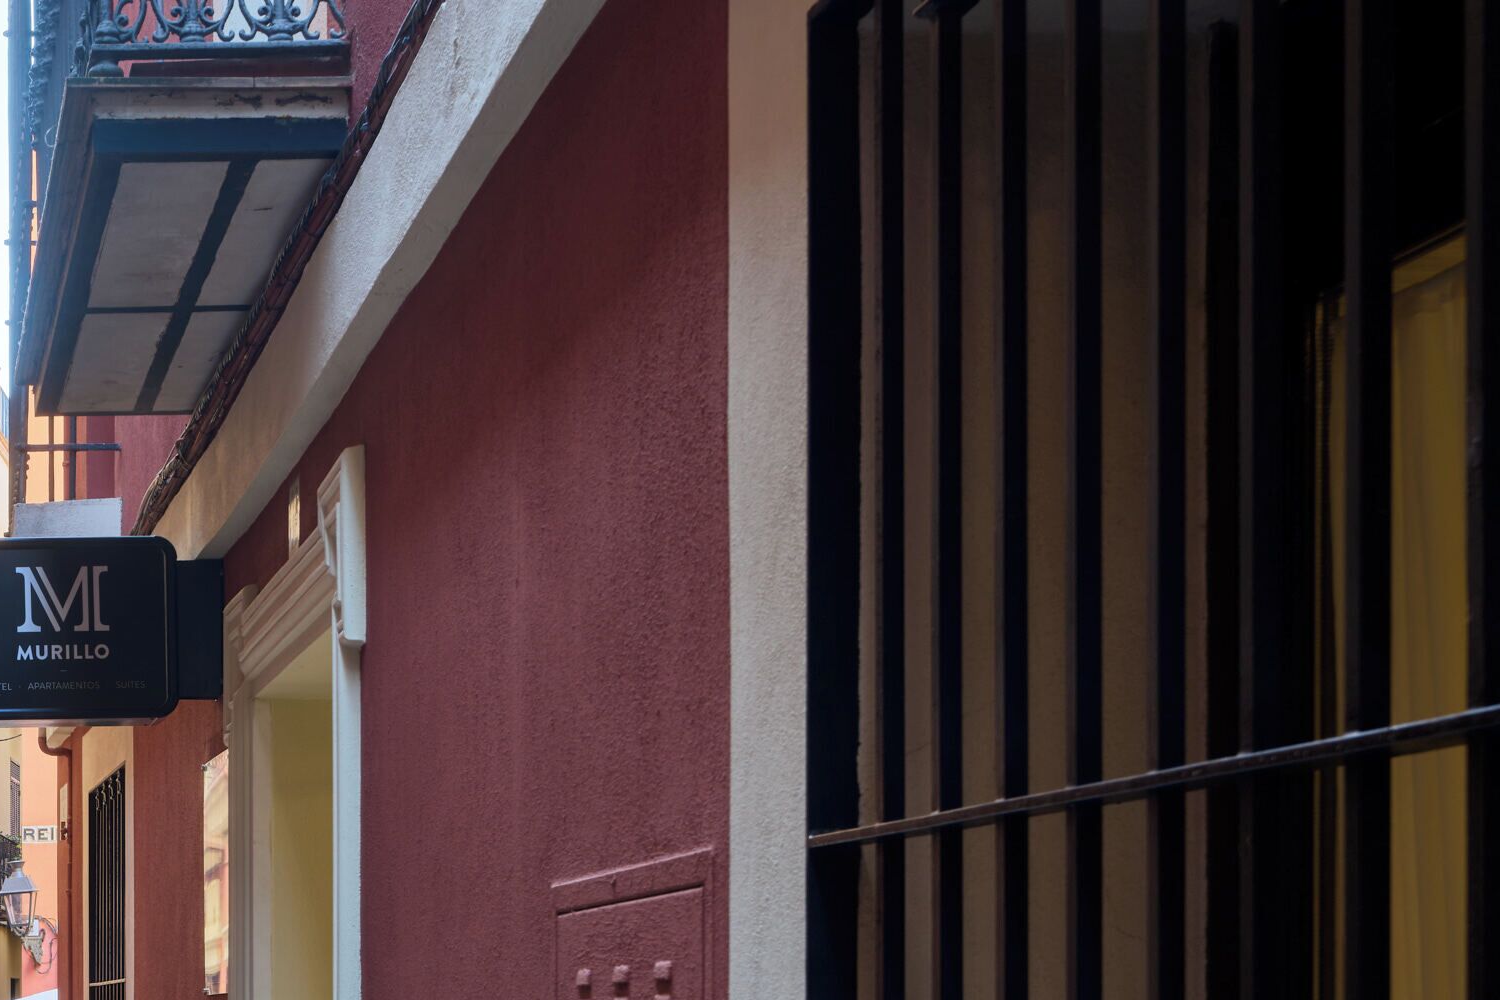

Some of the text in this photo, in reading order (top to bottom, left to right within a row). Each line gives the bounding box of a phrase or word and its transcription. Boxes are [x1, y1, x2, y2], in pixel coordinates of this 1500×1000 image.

[15, 565, 110, 632] M
[17, 643, 110, 661] MURILLO
[27, 681, 100, 690] APARTAMENTOS
[115, 680, 146, 689] SUITES
